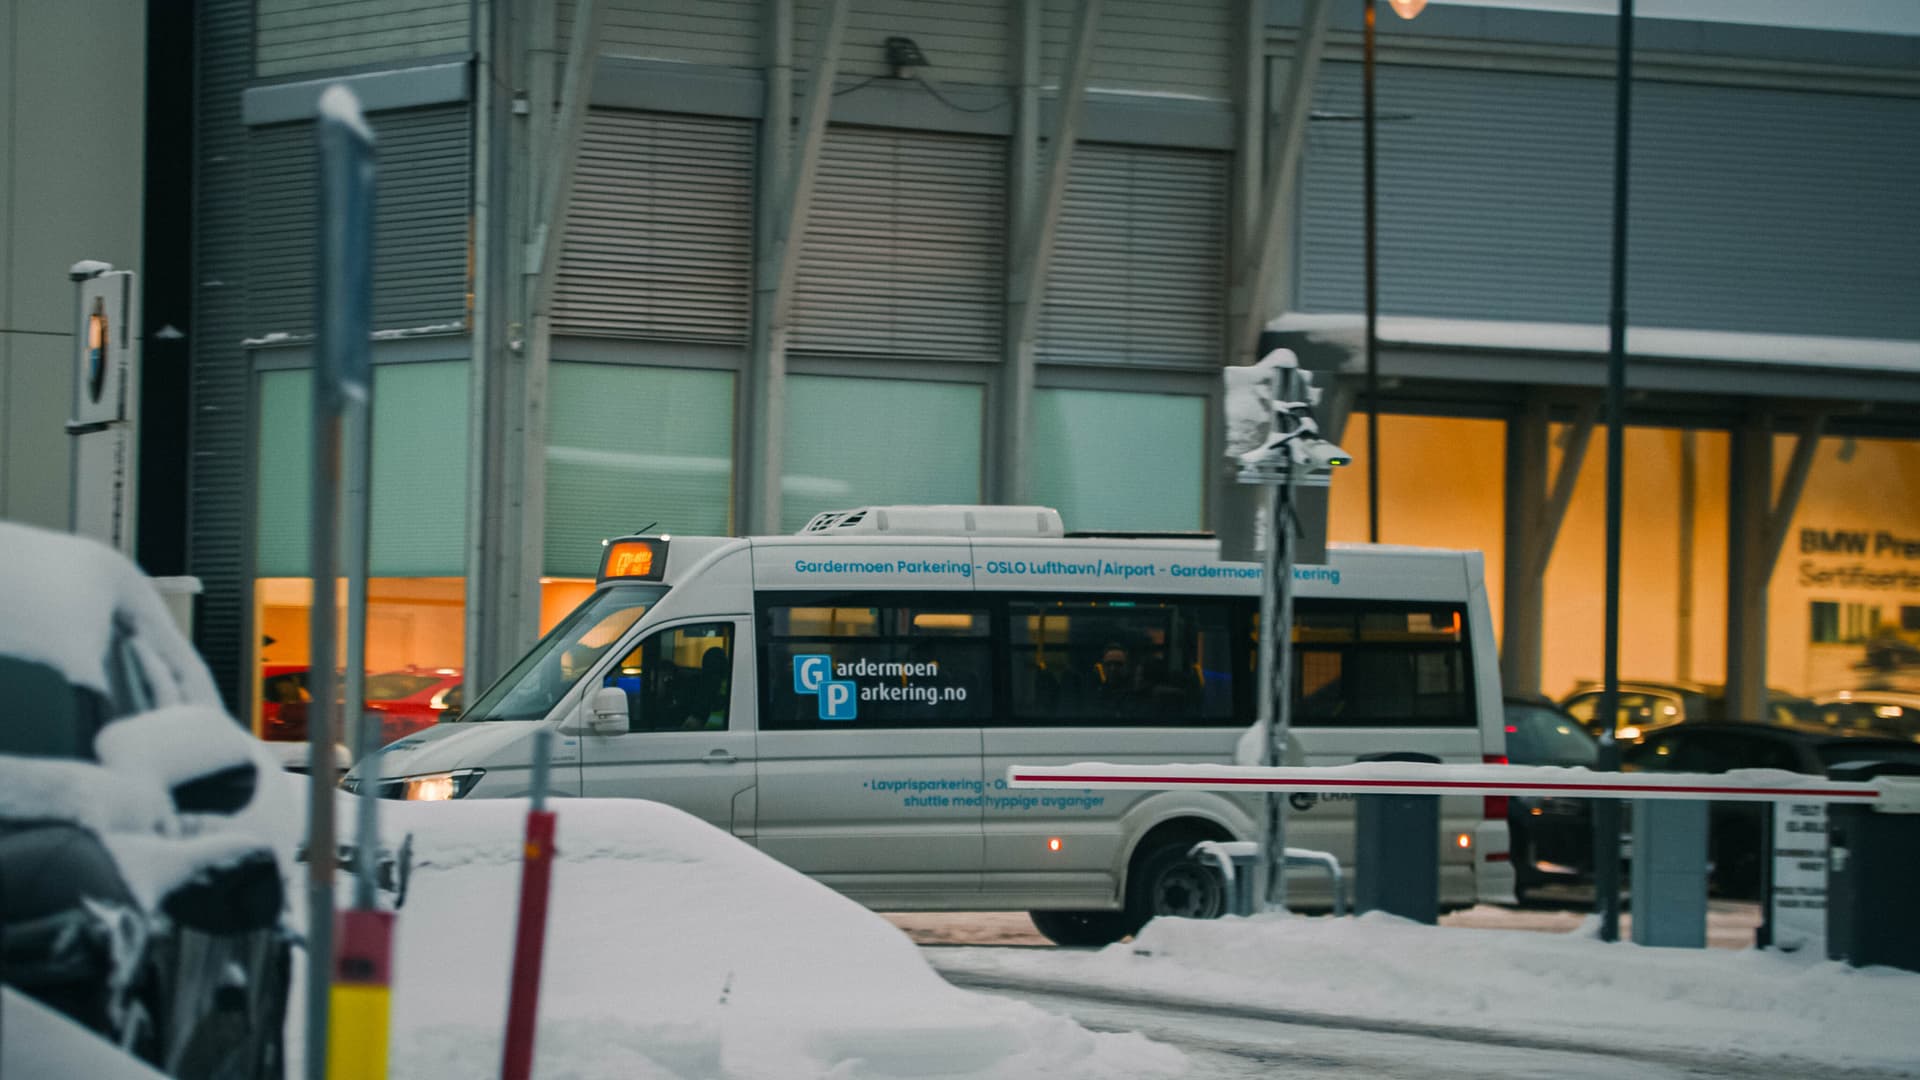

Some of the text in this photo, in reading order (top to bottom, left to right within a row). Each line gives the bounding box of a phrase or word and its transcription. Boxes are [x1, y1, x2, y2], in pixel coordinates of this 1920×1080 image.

[1800, 528, 1867, 554] BMW
[794, 559, 894, 574] Gardermoen
[897, 560, 972, 578] Parkering
[986, 561, 1027, 575] OSLO
[1029, 559, 1155, 580] Lufthavn/Airport
[871, 778, 983, 793] Lavprisparkering
[904, 795, 1105, 810] shuttle med hyppige avganger
